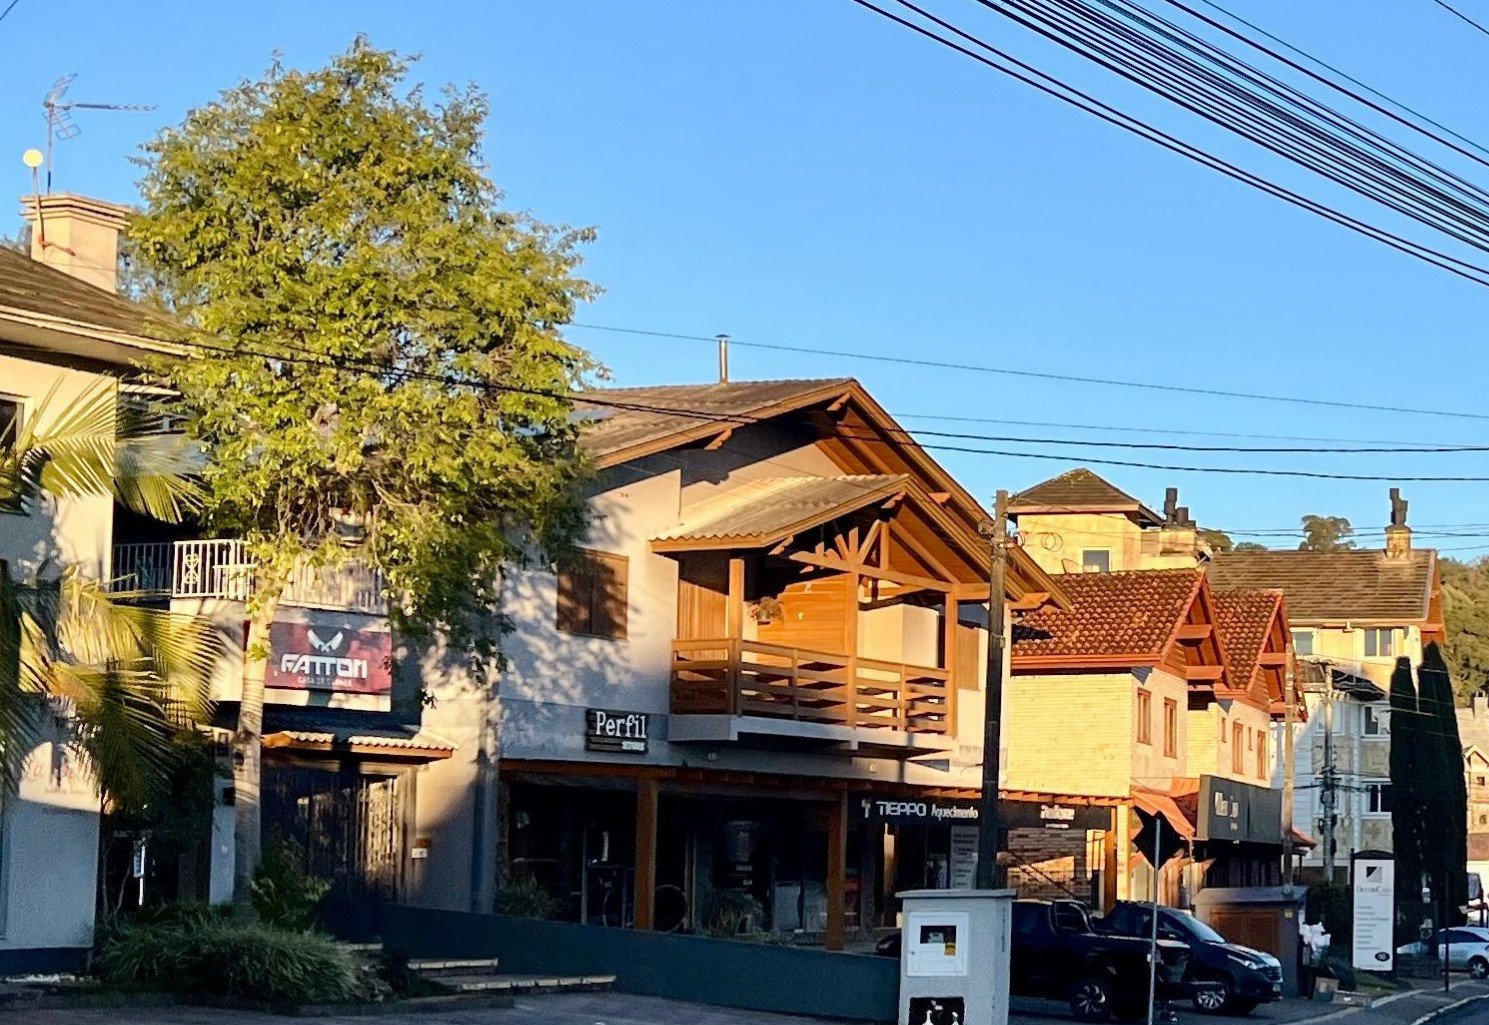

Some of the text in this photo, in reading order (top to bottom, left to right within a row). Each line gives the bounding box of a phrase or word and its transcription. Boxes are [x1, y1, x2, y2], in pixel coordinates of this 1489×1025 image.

[595, 710, 647, 738] Perfil
[876, 800, 979, 821] TIEPPO Aquecimento
